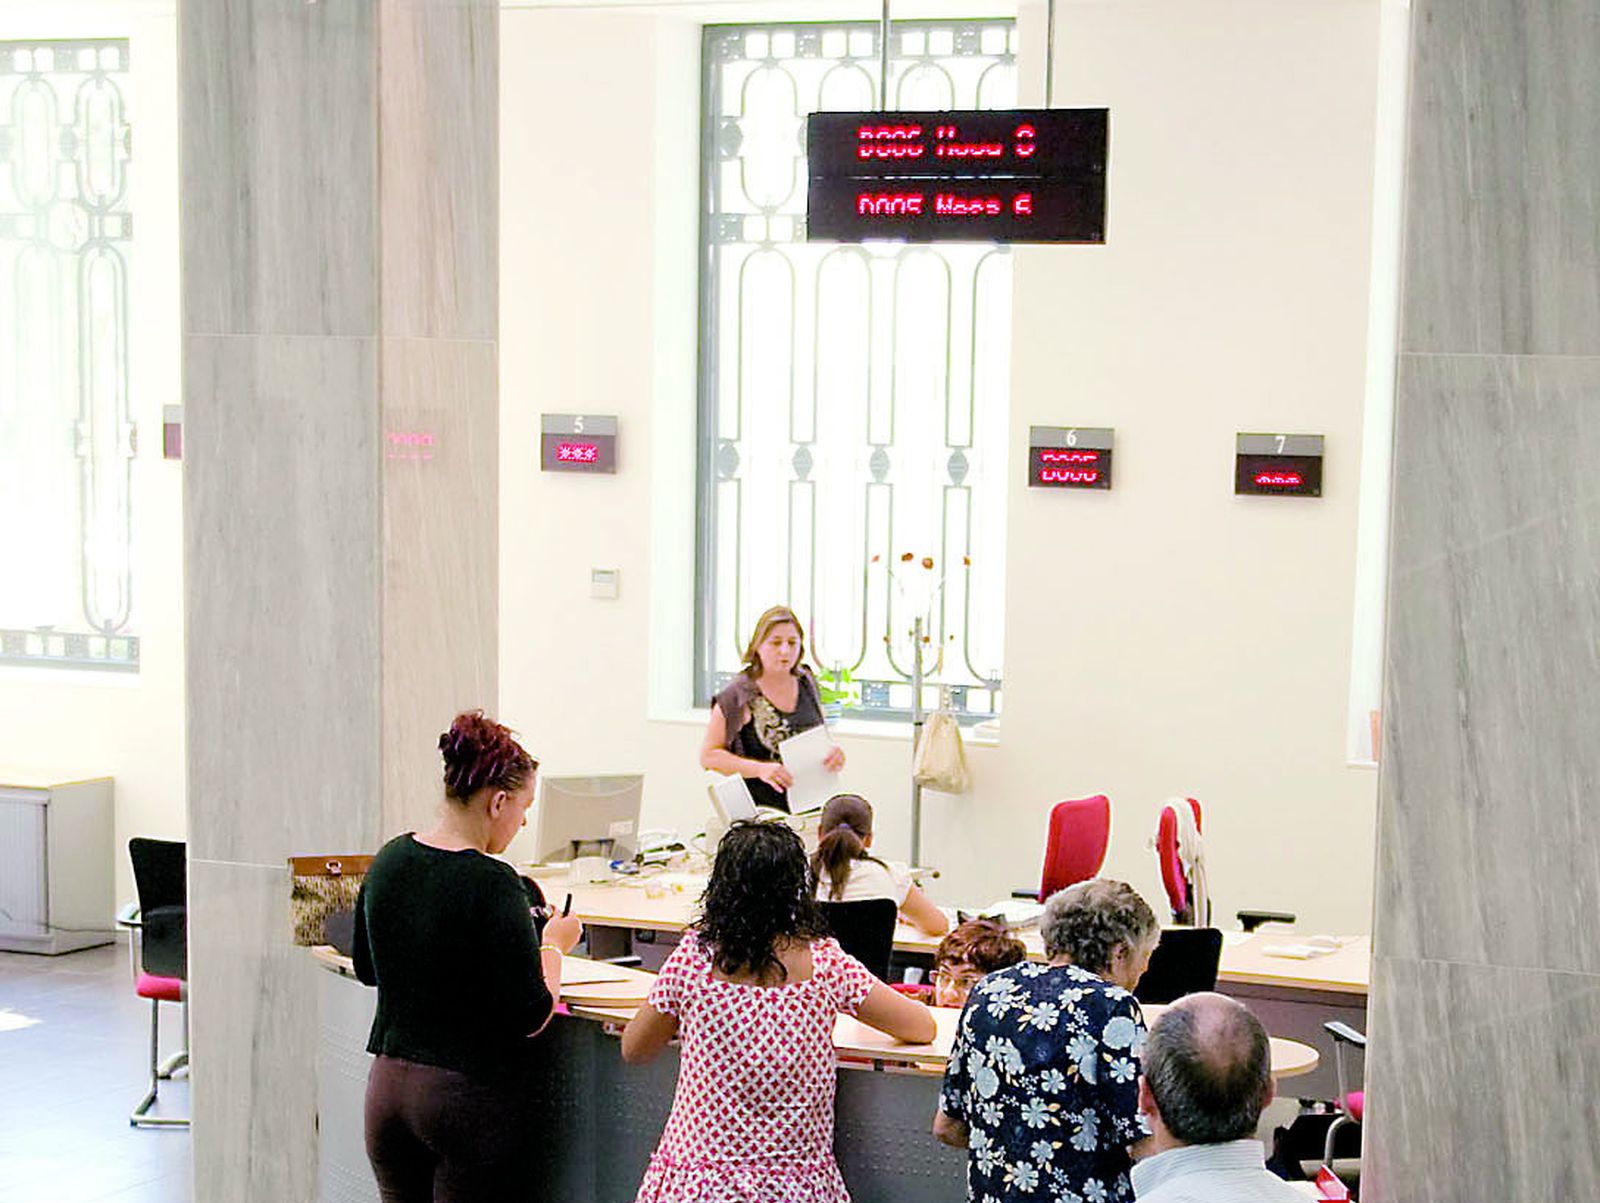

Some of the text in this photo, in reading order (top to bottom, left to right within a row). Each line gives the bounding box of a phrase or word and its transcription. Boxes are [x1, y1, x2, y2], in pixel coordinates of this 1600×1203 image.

[573, 415, 585, 434] 5
[1066, 429, 1077, 446] 6
[1274, 435, 1286, 454] 7
